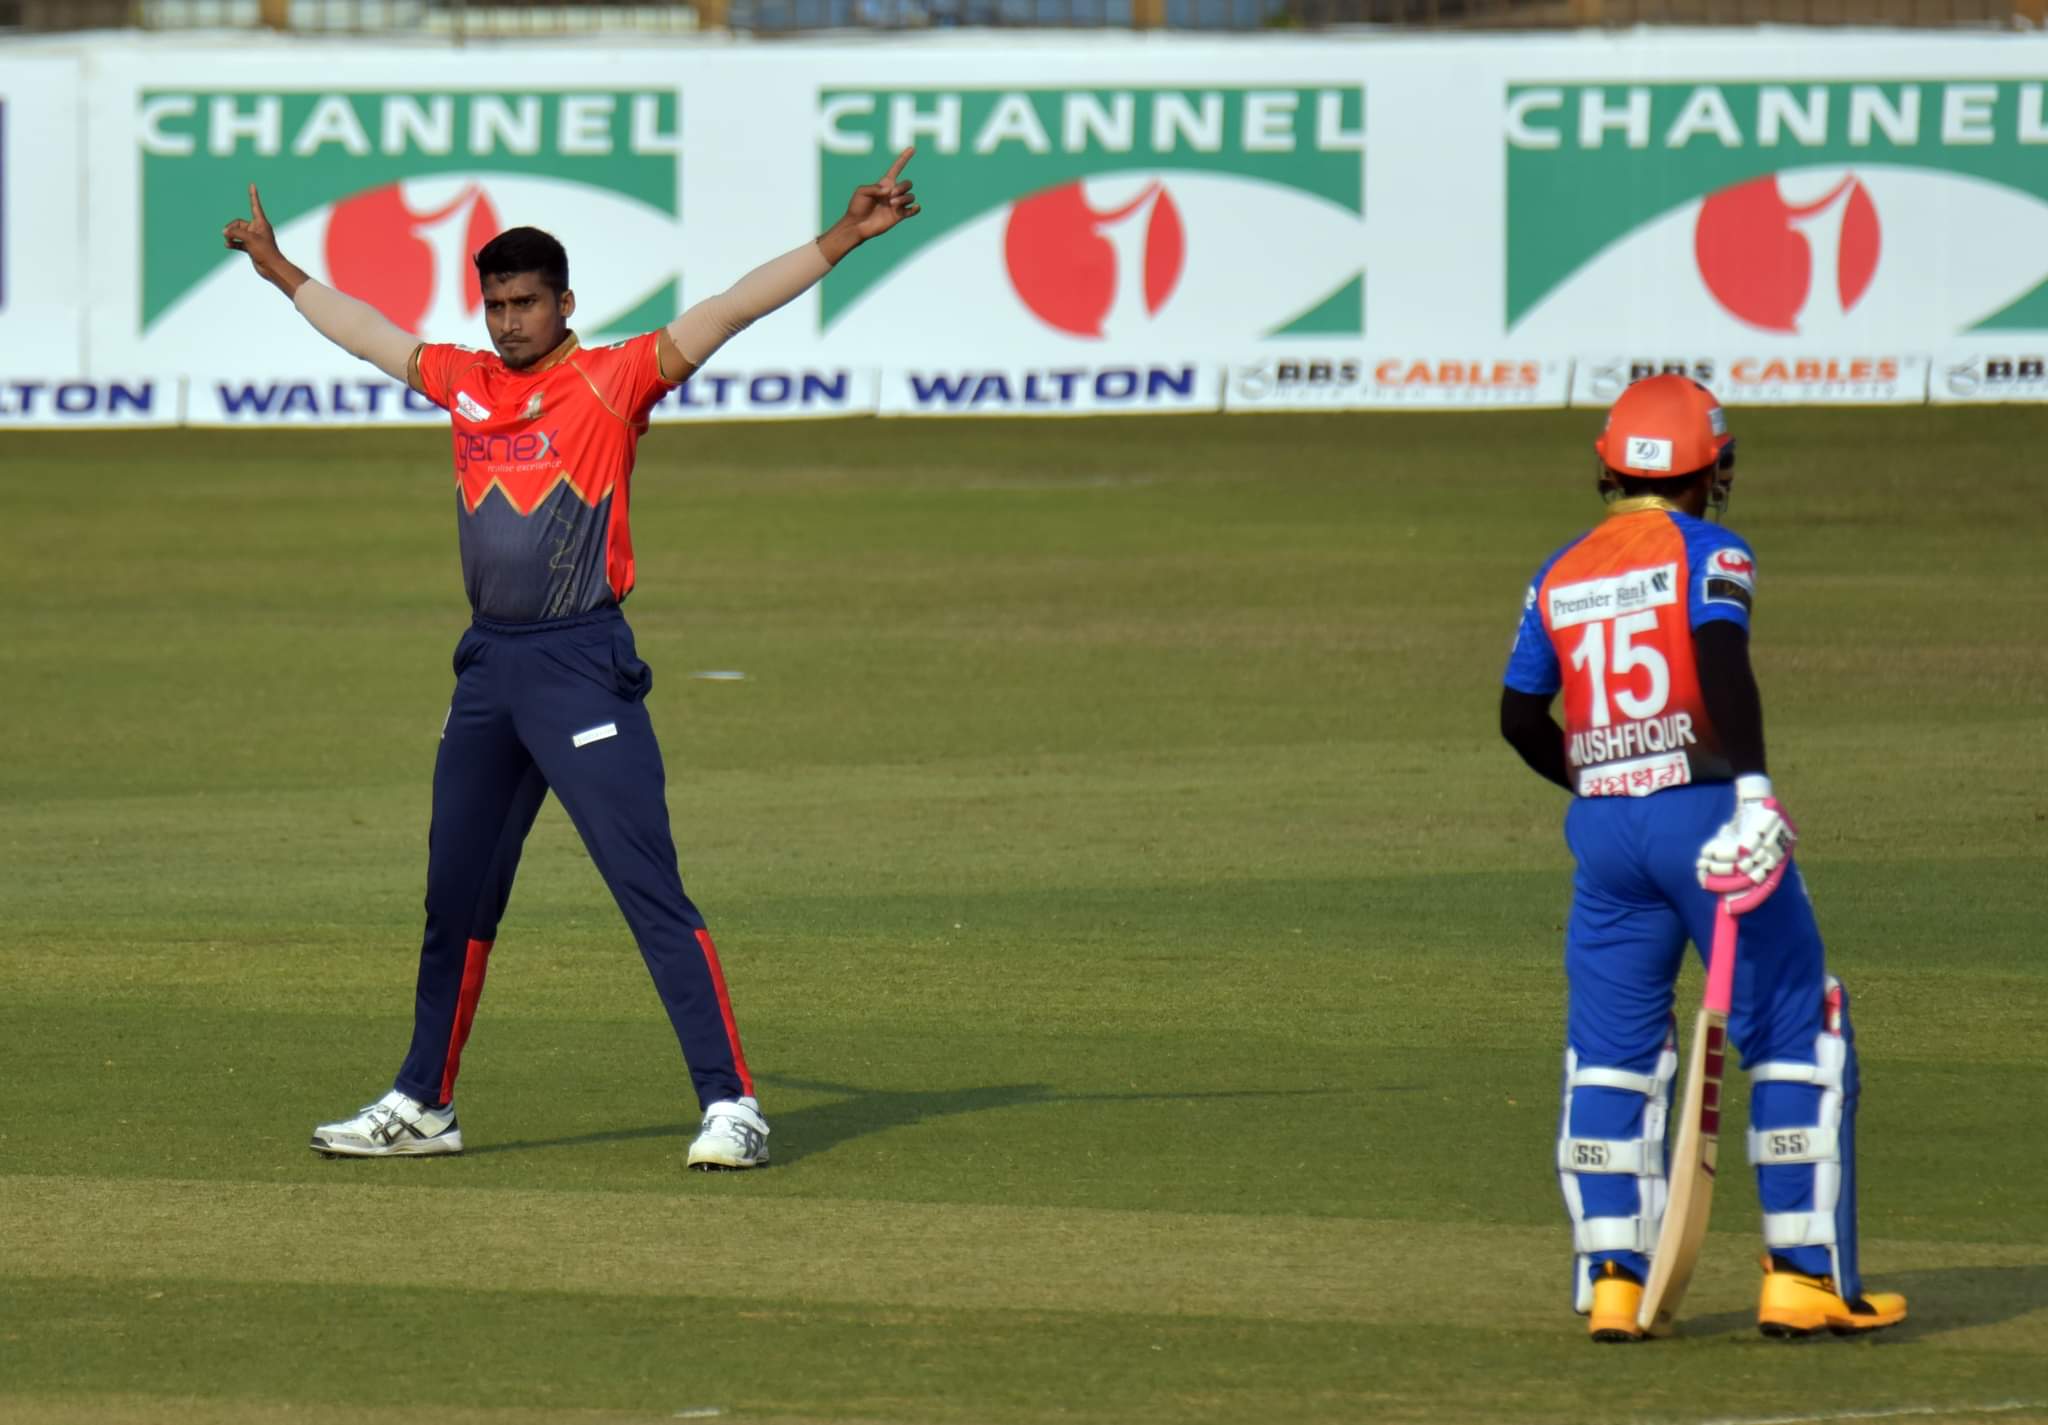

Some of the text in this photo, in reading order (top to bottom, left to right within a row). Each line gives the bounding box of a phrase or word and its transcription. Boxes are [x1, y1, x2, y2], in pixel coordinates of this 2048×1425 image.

[140, 95, 682, 155] CHANNEL
[818, 89, 1366, 153] CHANNEL
[1505, 83, 2048, 149] CHANNEL
[1373, 357, 1541, 386] CABLES
[1729, 356, 1899, 385] CABLES
[1986, 356, 2048, 383] BB
[0, 382, 155, 414] TON
[216, 382, 441, 414] WALTO
[911, 367, 1196, 405] WALTON
[456, 428, 561, 474] genex
[1552, 592, 1612, 616] Premier
[1570, 609, 1670, 728] 15
[1576, 1144, 1605, 1166] SS
[1773, 1134, 1804, 1155] SS
